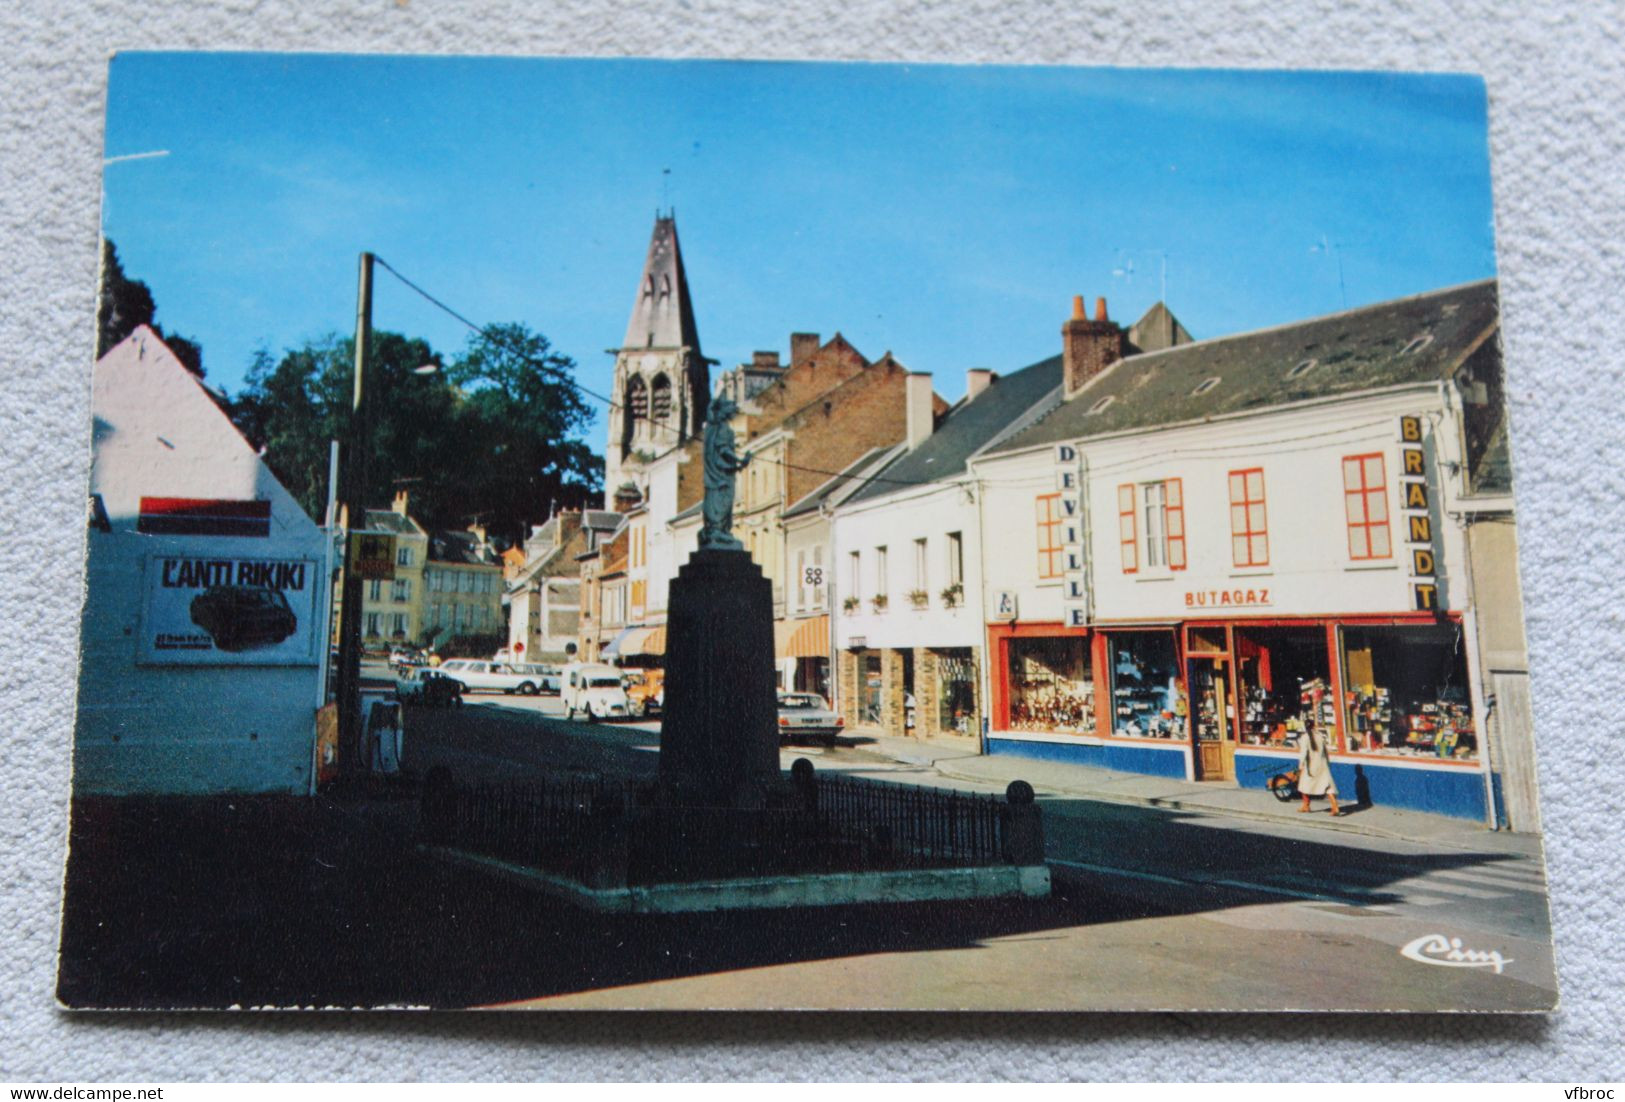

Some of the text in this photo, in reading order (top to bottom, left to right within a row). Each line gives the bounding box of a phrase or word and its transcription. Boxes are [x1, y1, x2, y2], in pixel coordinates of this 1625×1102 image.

[1060, 446, 1084, 625] DEVILLE
[1402, 418, 1434, 608] BRANDT
[162, 560, 232, 588] L'ANTI
[1185, 589, 1269, 606] BUTAGAZ
